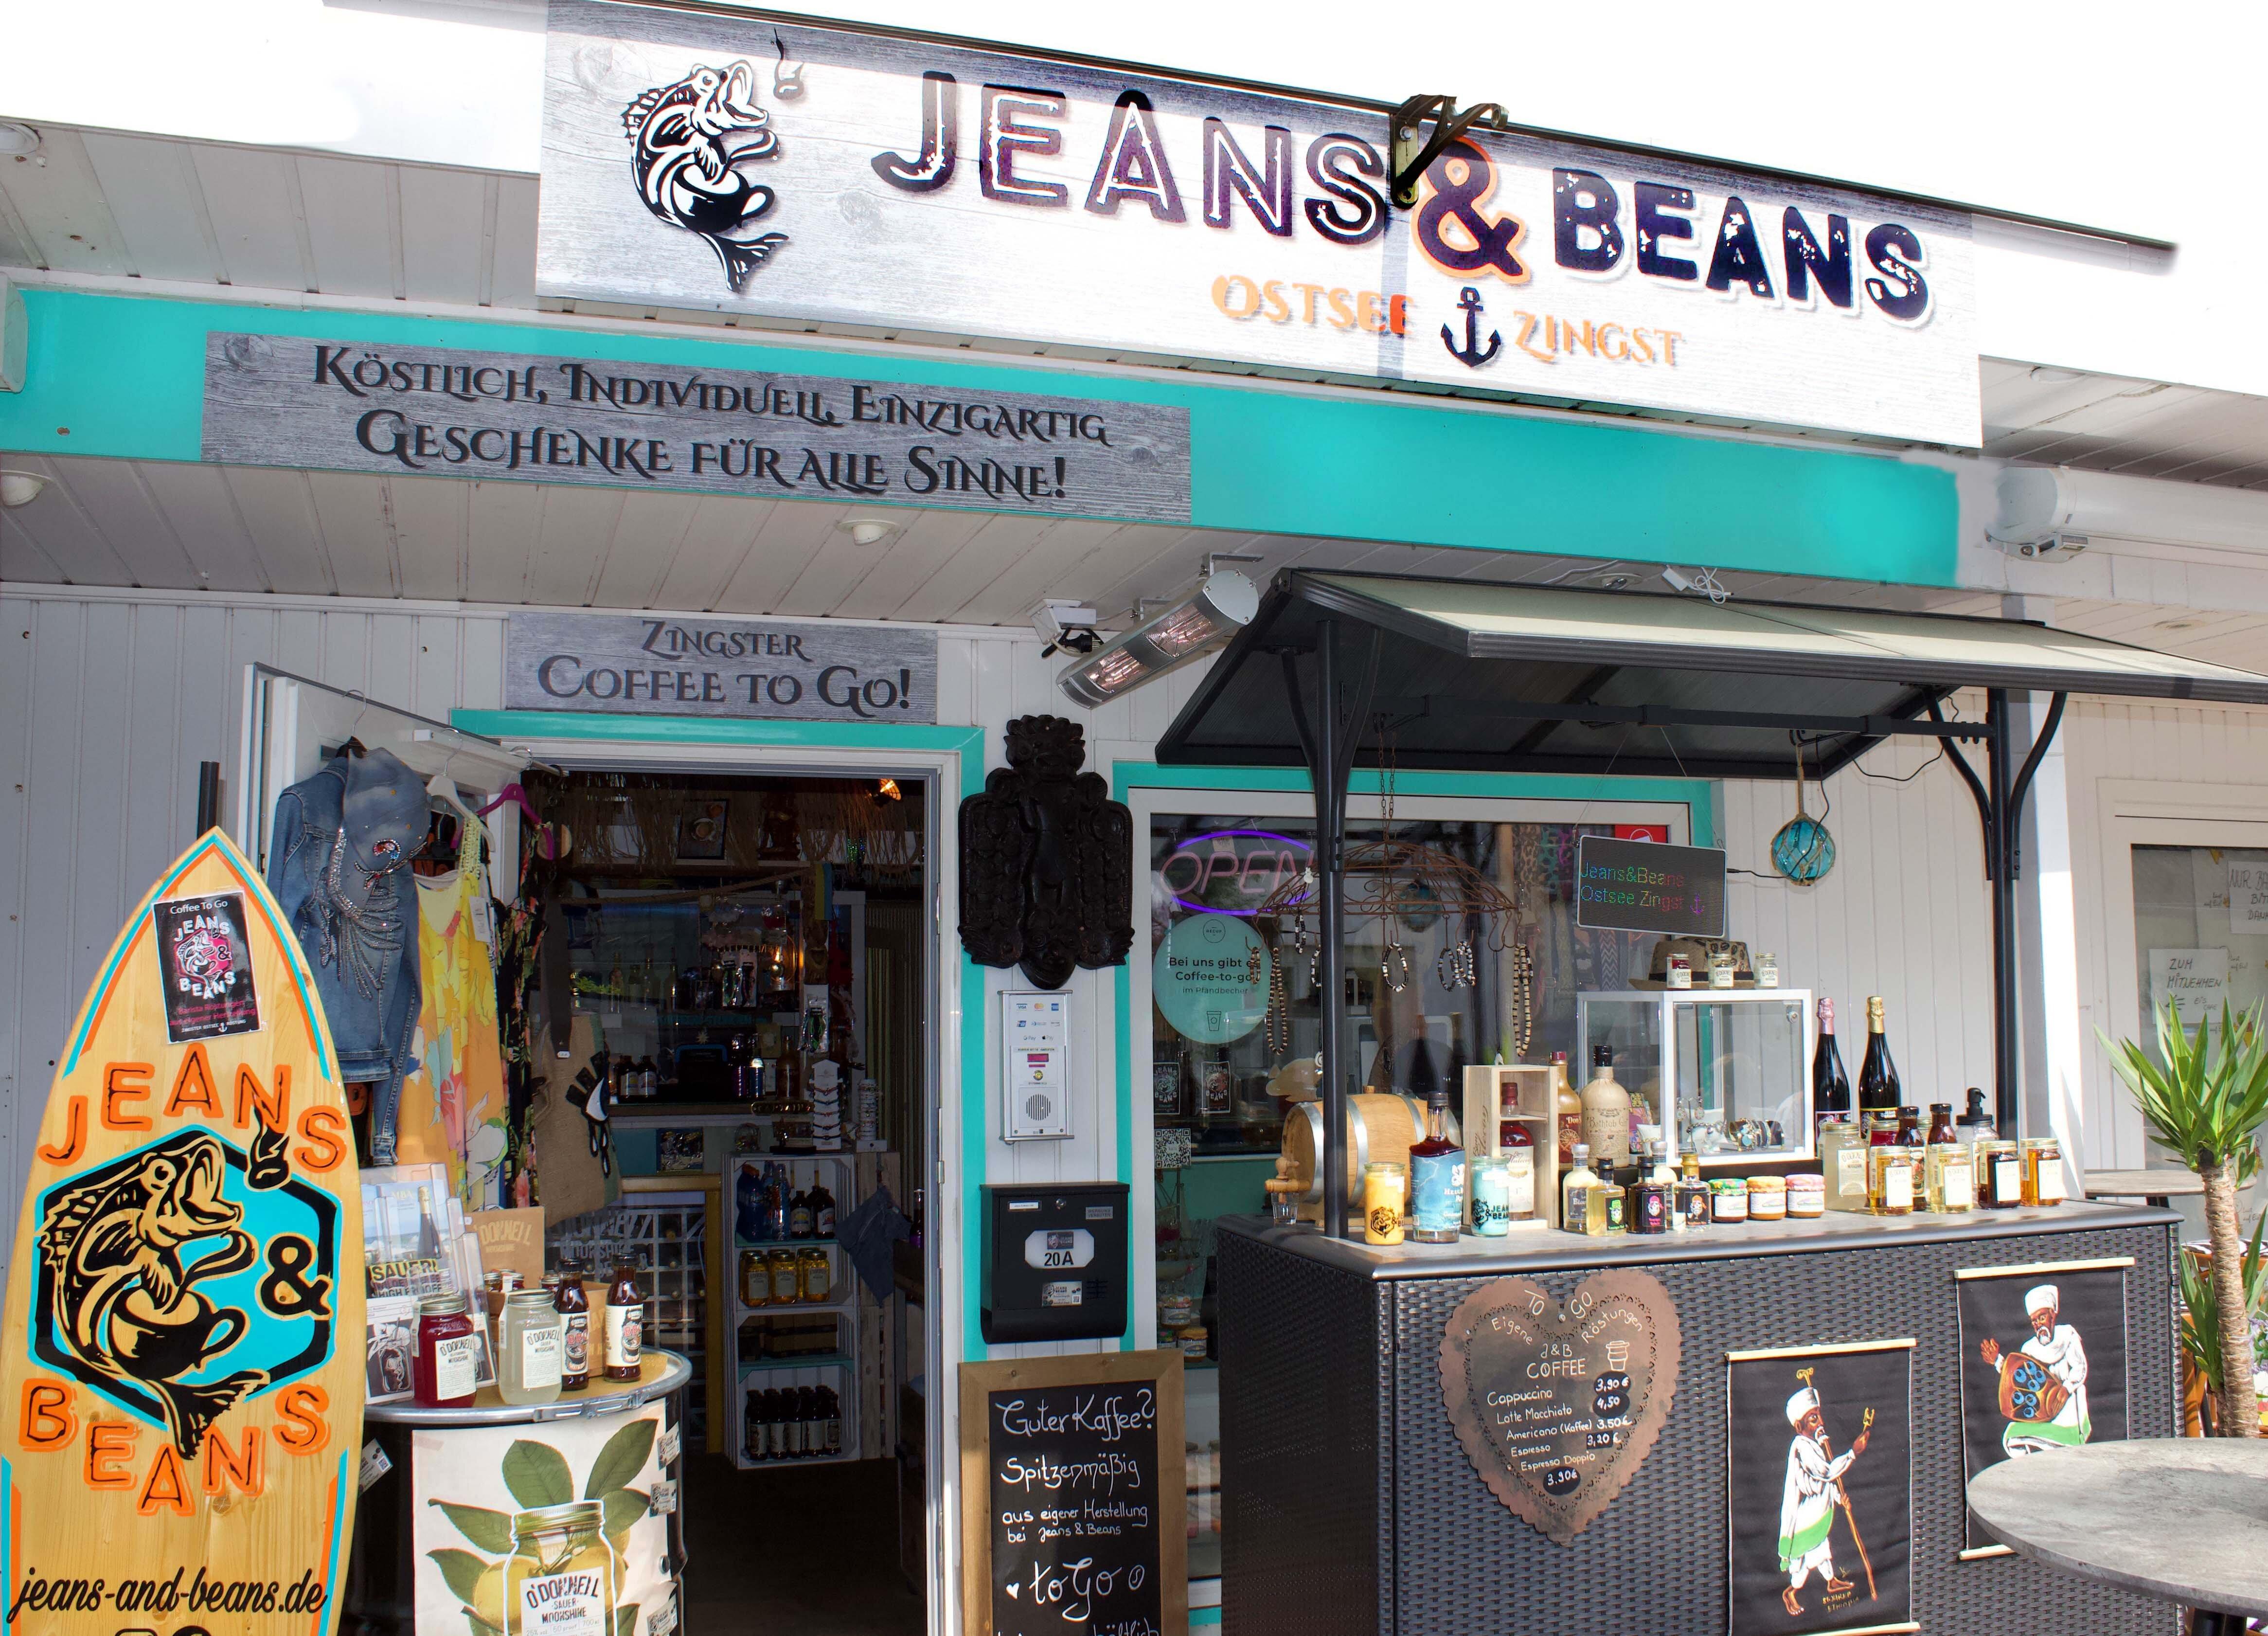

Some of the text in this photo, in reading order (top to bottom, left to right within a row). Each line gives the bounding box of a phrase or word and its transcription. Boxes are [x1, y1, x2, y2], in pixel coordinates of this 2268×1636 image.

[871, 70, 1932, 322] JEANS & BEANS
[1211, 276, 1684, 366] OSTSEE ZINGST
[851, 385, 1114, 447] EINZIGARTIG
[356, 409, 674, 480] GESCHENKE
[797, 448, 890, 496] ALLE
[904, 445, 1067, 502] SINNE!
[642, 620, 813, 663] ZINGSTER
[537, 655, 911, 718] COFFEE TO GO!
[1160, 850, 1314, 895] OPEN
[170, 905, 200, 915] Coffee
[201, 902, 212, 910] To
[1581, 883, 1635, 905] Ostsee
[174, 915, 231, 942] JEANS
[217, 945, 232, 960] &
[1169, 957, 1188, 966] Bei
[1218, 958, 1242, 969] gibt
[179, 971, 237, 1000] BEANS
[1176, 971, 1252, 983] Coffee-to-go
[35, 1043, 347, 1173] JEANS
[260, 1234, 333, 1319] &
[1524, 1289, 1545, 1315] TO
[1491, 1309, 1643, 1346] Eigene Röstungen
[1526, 1358, 1586, 1379] COFFEE
[1487, 1385, 1553, 1407] Cappuccino
[995, 1388, 1156, 1441] Guter Kaffee?
[1497, 1409, 1522, 1424] Latte
[1525, 1402, 1572, 1420] Macchiato
[1506, 1426, 1557, 1441] Americano
[1560, 1419, 1592, 1434] (Kaffee)
[18, 1378, 333, 1518] BEANS
[1511, 1444, 1551, 1457] Espresso
[1520, 1451, 1596, 1473] Espresso Doppio
[1000, 1453, 1141, 1496] Spitzenmäßig
[1002, 1499, 1148, 1528] aus eigener Herstellung
[1007, 1522, 1122, 1544] bei Jeans & Beans
[6, 1566, 329, 1624] jeans-and-beans.de
[526, 1575, 599, 1608] O'DONNELL
[541, 1606, 587, 1624] MOONSHINE
